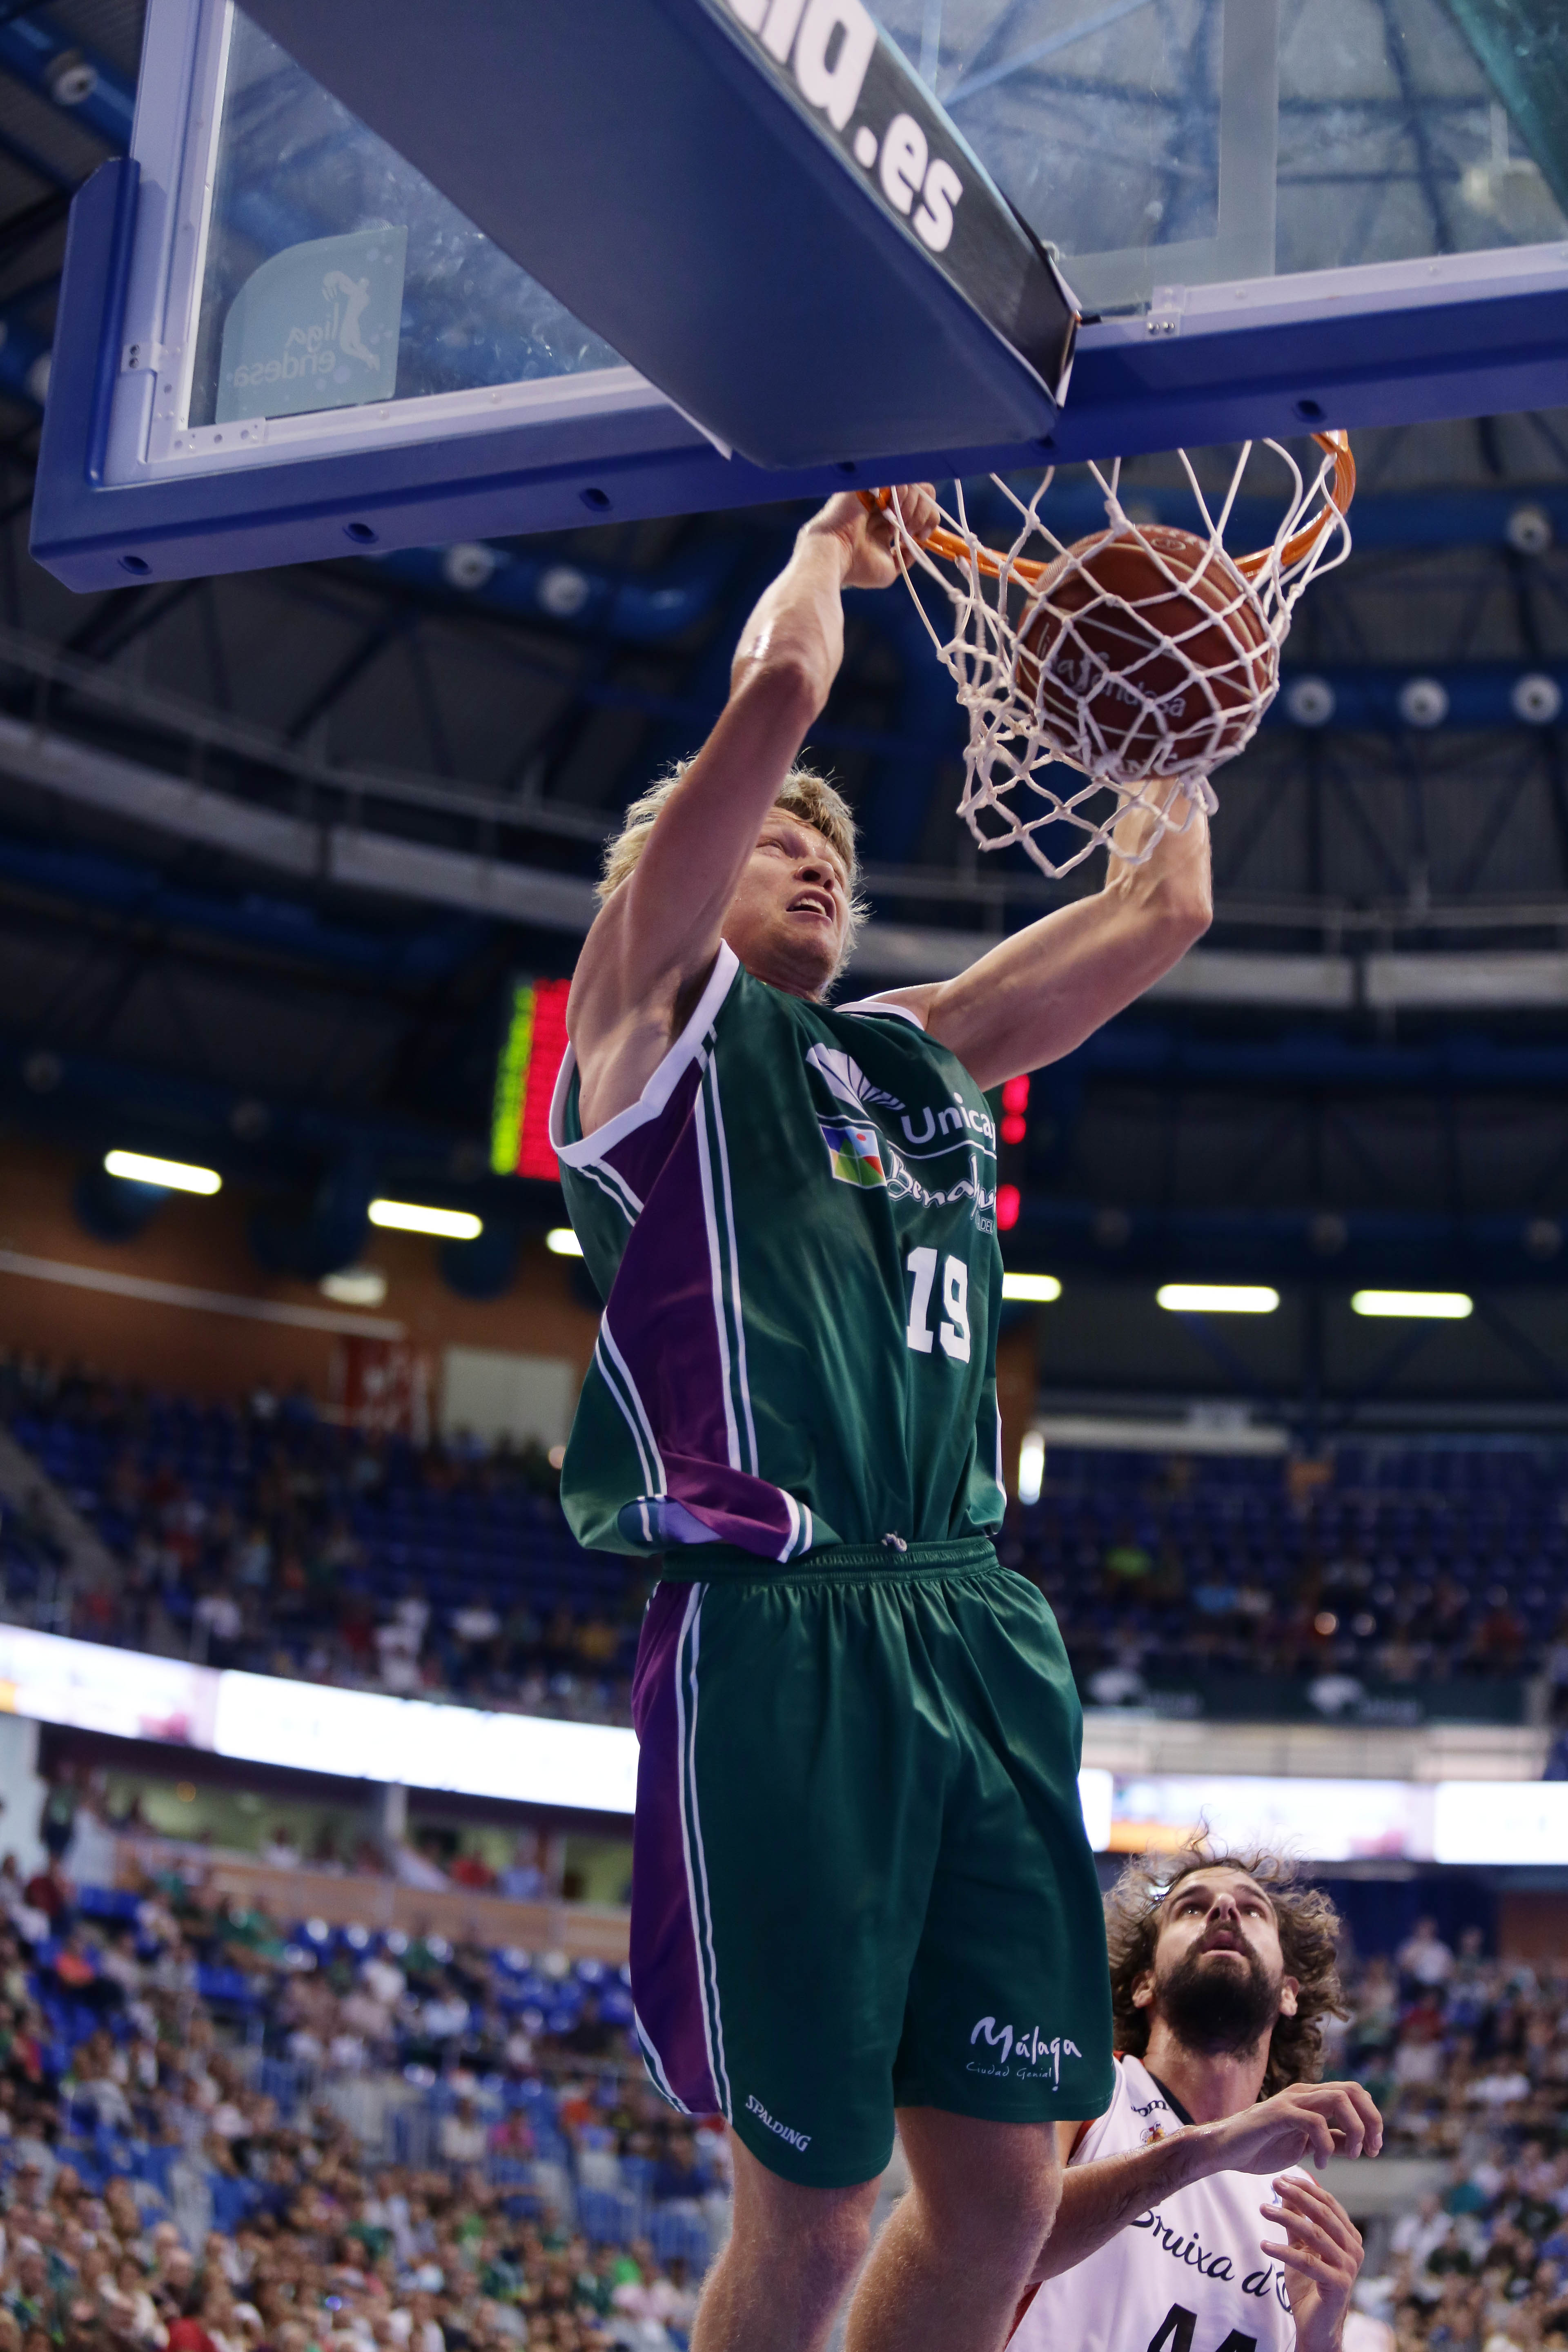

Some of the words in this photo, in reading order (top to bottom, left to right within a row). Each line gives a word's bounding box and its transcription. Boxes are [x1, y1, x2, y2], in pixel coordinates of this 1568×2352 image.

[907, 1247, 971, 1363] 19
[967, 2062, 1009, 2077] Ciudad
[1017, 2068, 1051, 2080] Genial
[971, 2017, 1082, 2091] Málaga
[745, 2094, 812, 2152] SPALDING
